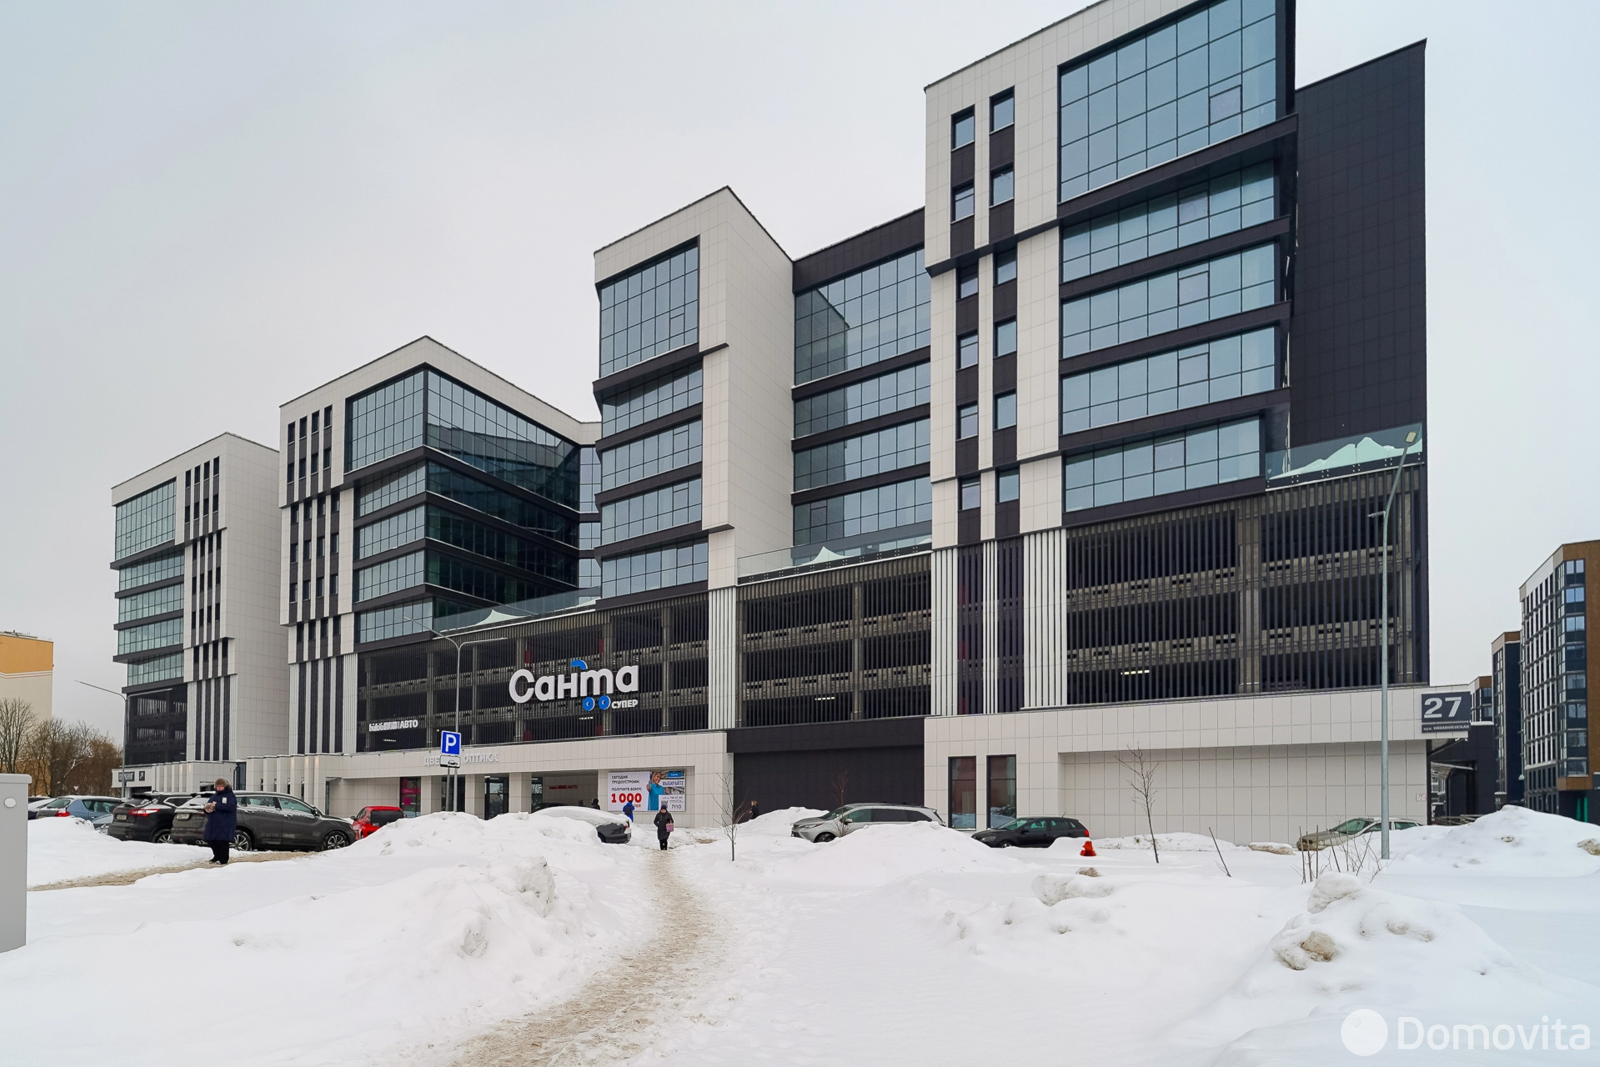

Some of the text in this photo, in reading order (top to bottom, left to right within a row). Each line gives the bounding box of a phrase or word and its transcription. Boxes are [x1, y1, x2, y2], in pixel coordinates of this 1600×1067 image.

[508, 665, 639, 703] Санта
[611, 699, 638, 709] СУПЕР
[1424, 697, 1462, 718] 27
[400, 719, 419, 729] АВТО
[445, 734, 457, 752] P
[464, 753, 499, 763] ОПТИКА
